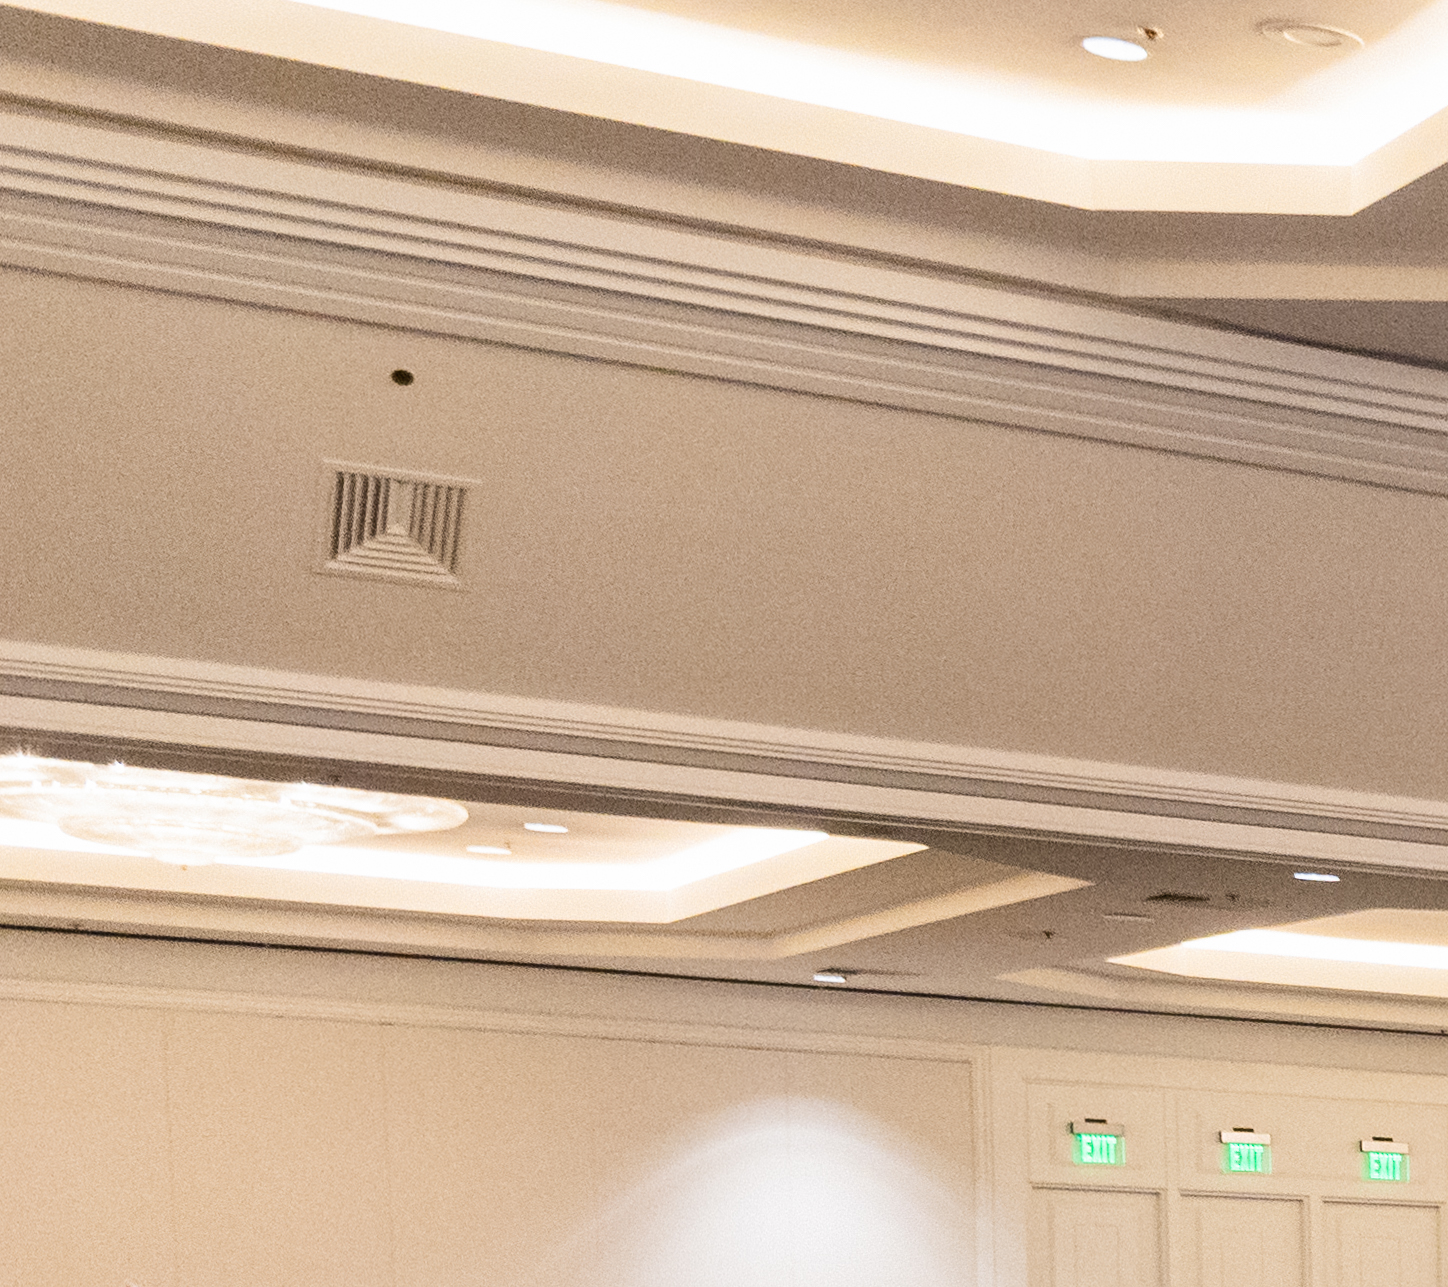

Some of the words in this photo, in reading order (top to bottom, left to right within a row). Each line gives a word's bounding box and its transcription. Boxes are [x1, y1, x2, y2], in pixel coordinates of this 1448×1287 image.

[1080, 1134, 1117, 1164] EXIT
[1229, 1144, 1264, 1172] EXIT
[1369, 1153, 1402, 1180] EXIT
